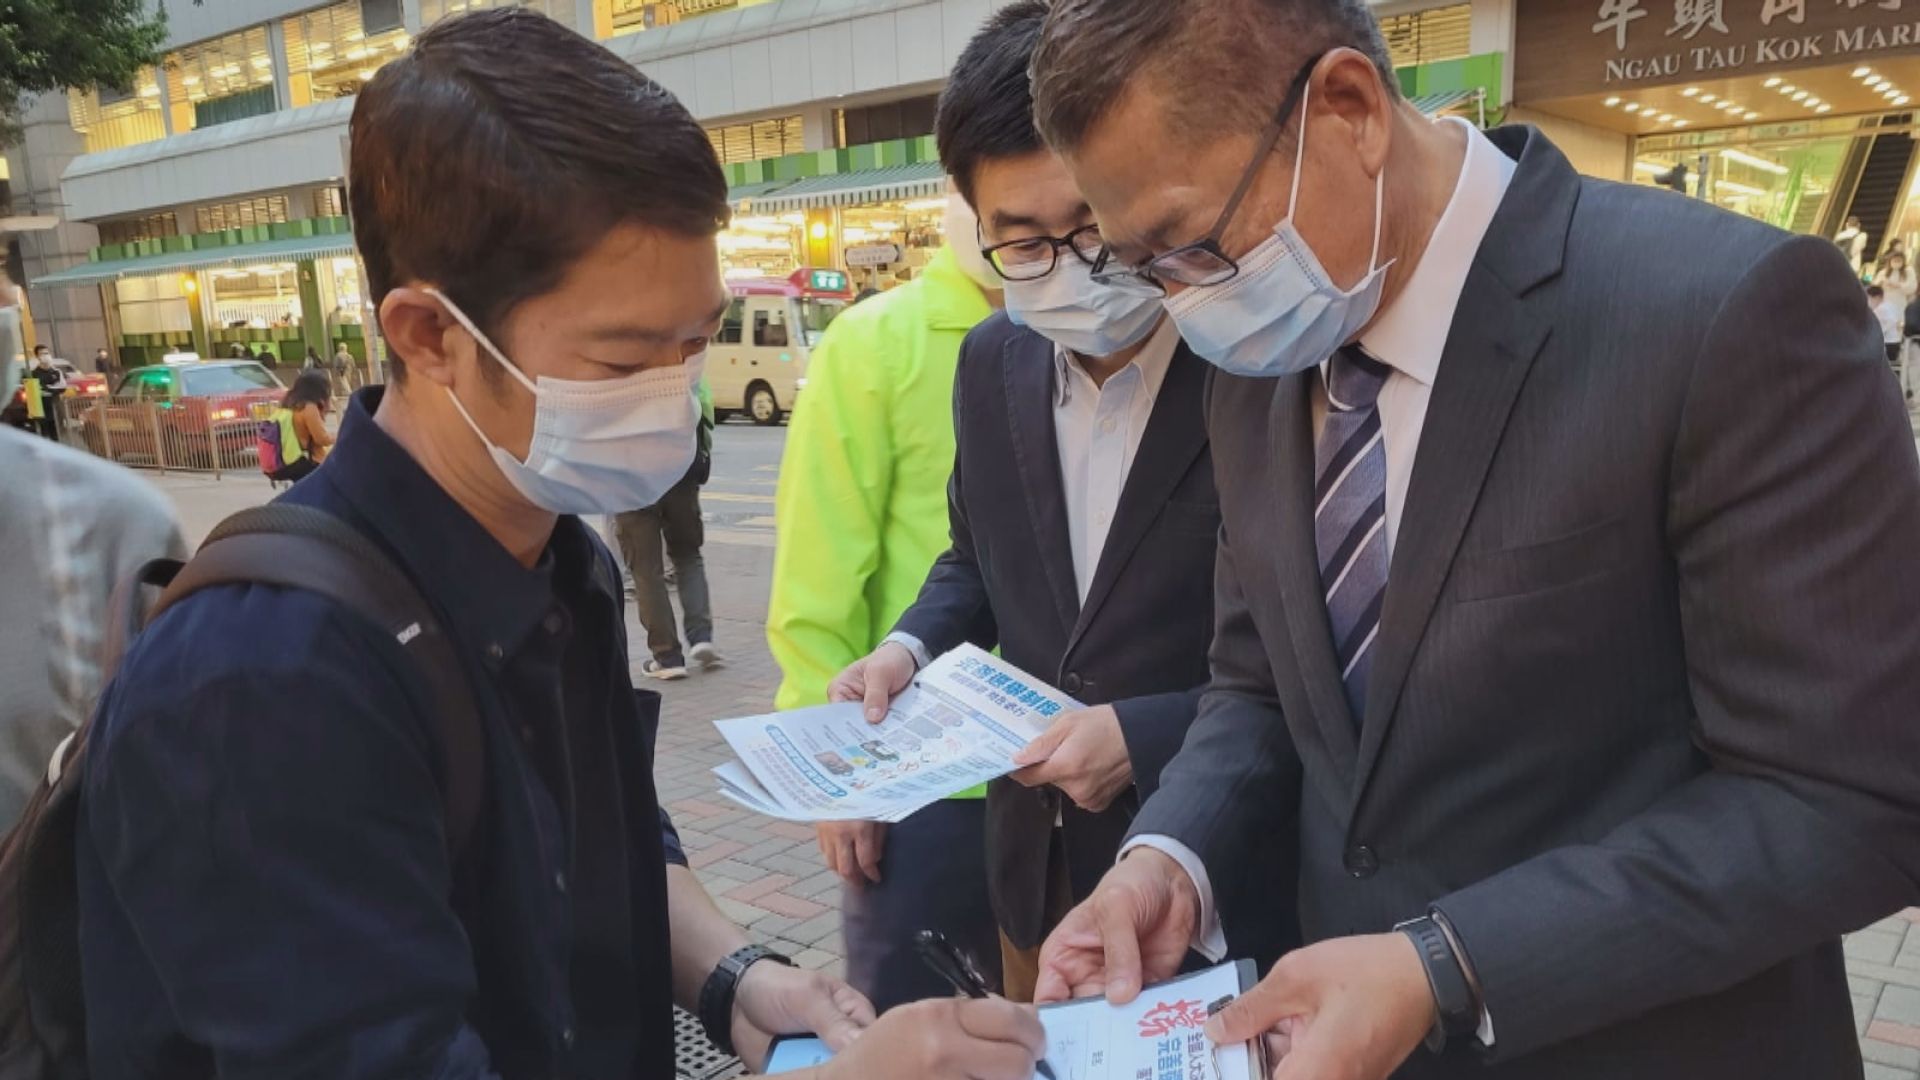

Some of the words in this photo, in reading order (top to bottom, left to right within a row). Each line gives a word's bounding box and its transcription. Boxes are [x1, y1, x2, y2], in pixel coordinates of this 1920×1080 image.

[1592, 0, 1902, 50] 牛頭
[1604, 54, 1682, 82] NGAU
[1690, 44, 1746, 71] TAU
[1755, 34, 1823, 63] KOK
